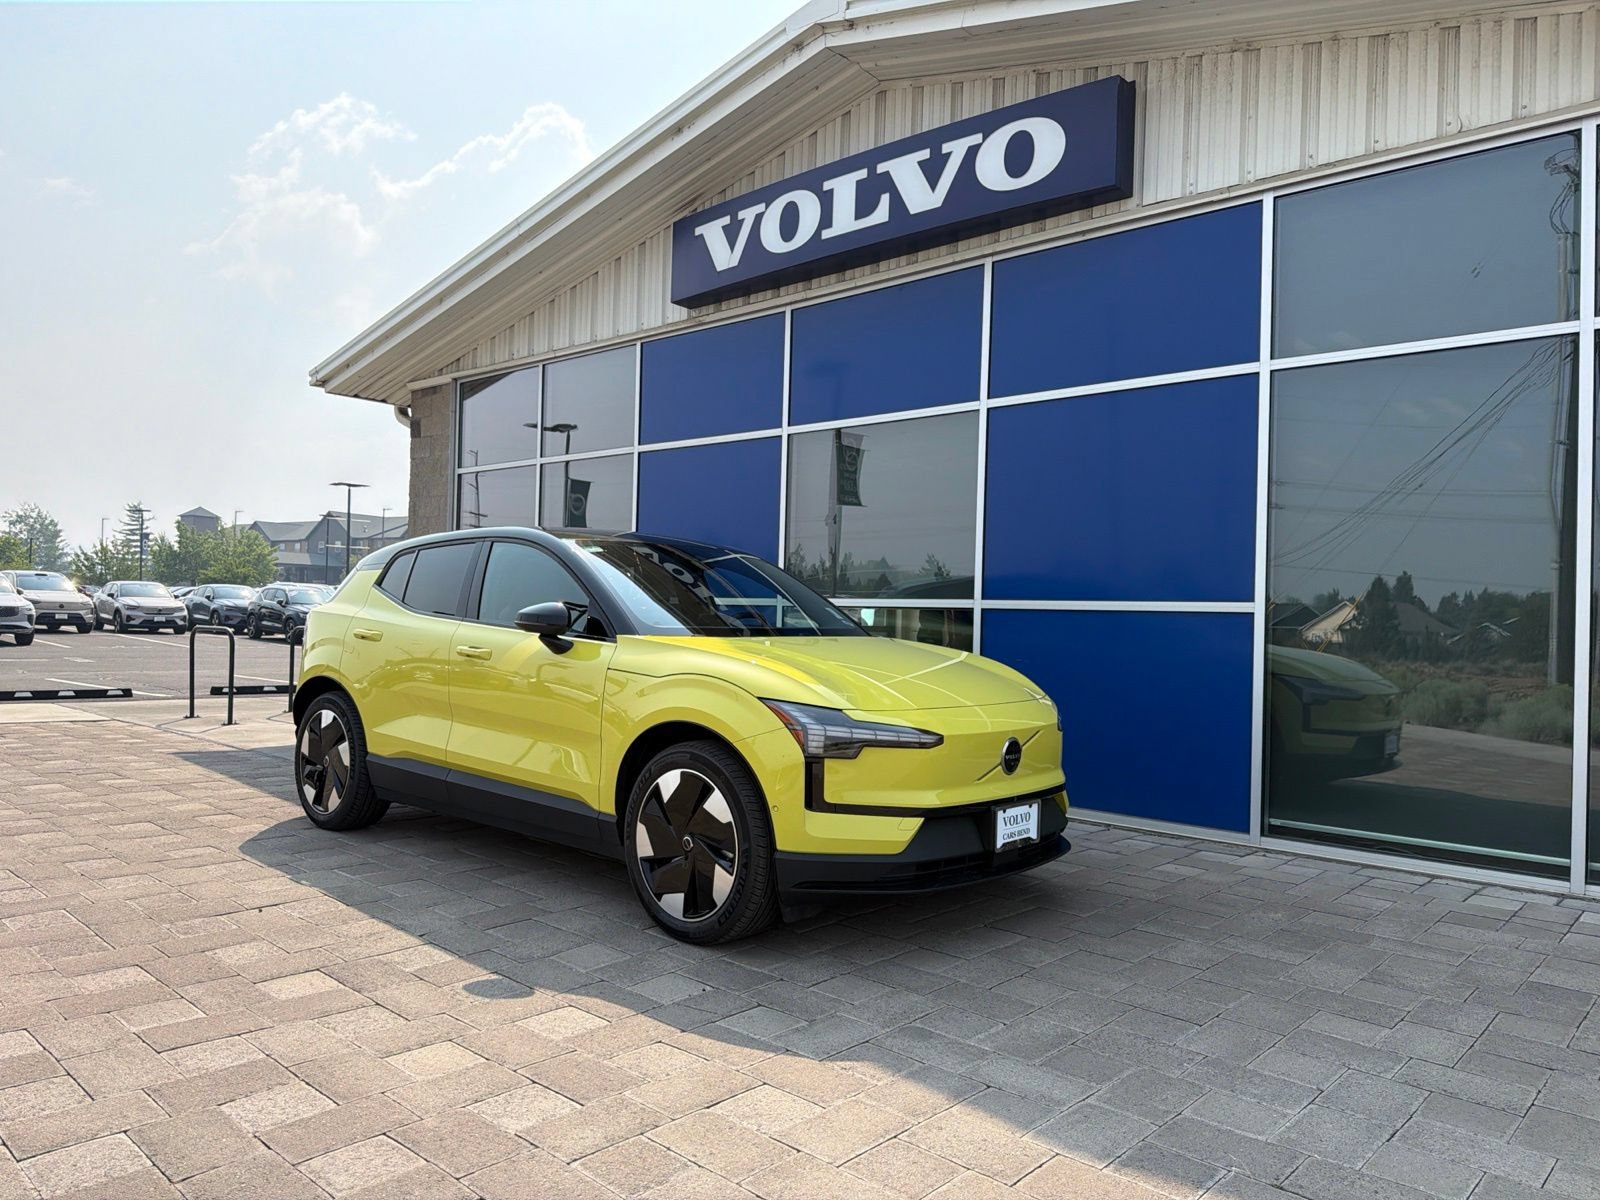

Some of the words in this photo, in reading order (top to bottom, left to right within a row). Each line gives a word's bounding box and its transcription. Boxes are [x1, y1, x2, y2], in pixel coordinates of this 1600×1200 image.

[695, 117, 1066, 272] VOLVO
[1003, 812, 1030, 827] VOLVO
[1003, 831, 1016, 840] CARS
